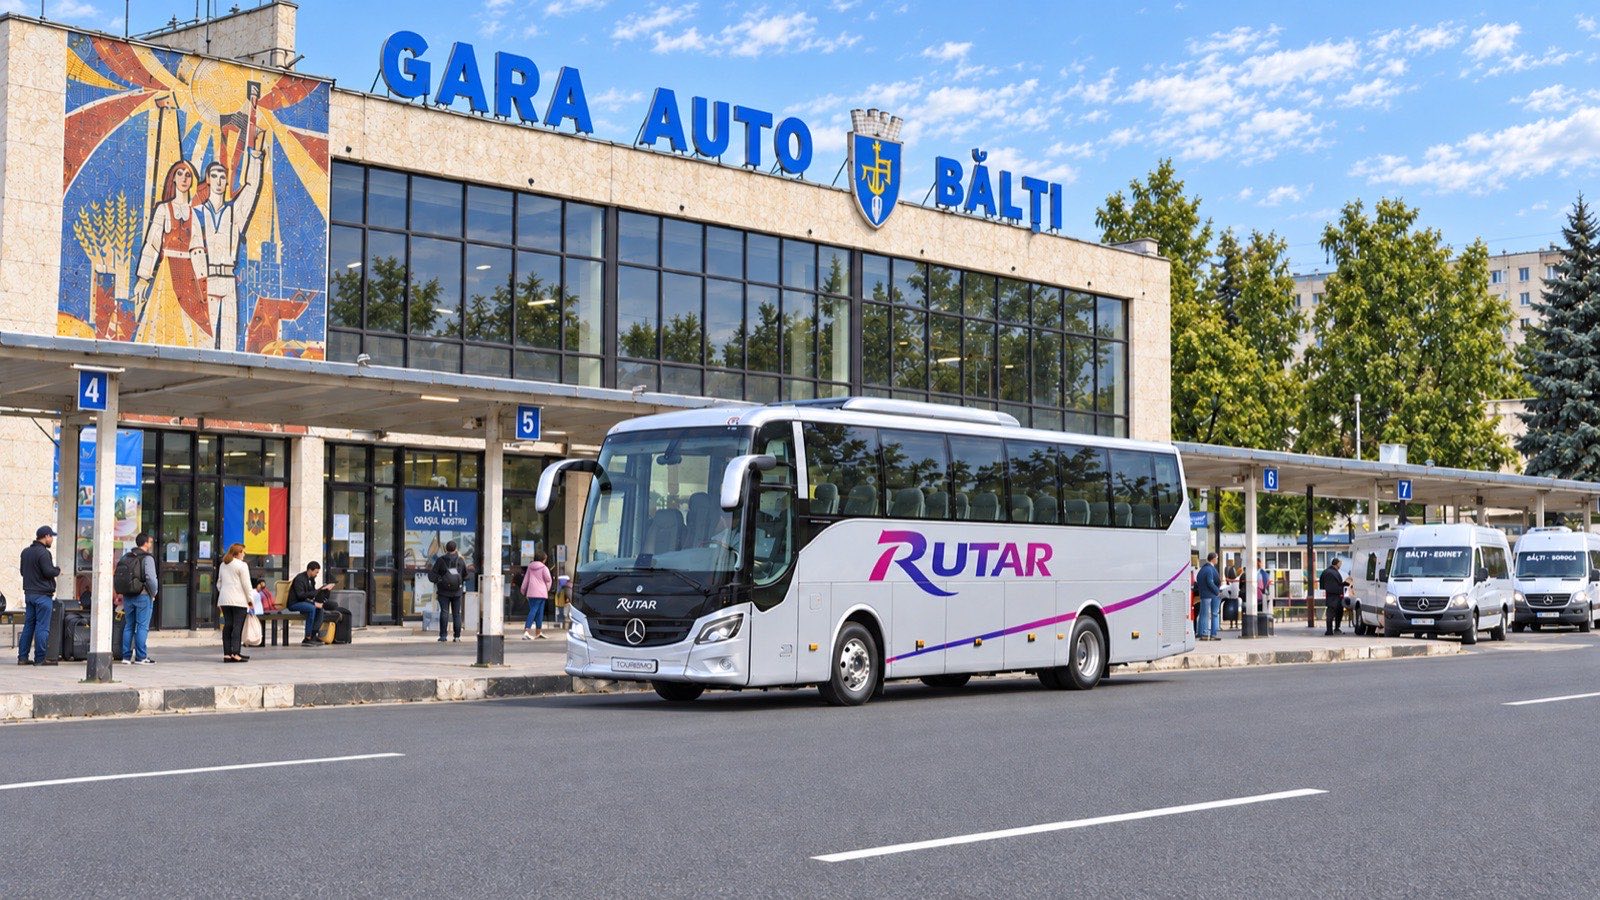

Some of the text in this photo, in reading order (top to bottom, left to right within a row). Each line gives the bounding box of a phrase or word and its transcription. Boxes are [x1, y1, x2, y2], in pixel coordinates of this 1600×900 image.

[379, 30, 1062, 234] GARA AUTO BĂLȚI
[85, 377, 99, 403] 4
[523, 411, 534, 434] 5
[1268, 470, 1275, 488] 6
[1401, 482, 1409, 497] 7
[441, 516, 468, 526] NOSTRU
[868, 529, 1054, 597] RUTAR
[616, 597, 657, 612] RUTAR
